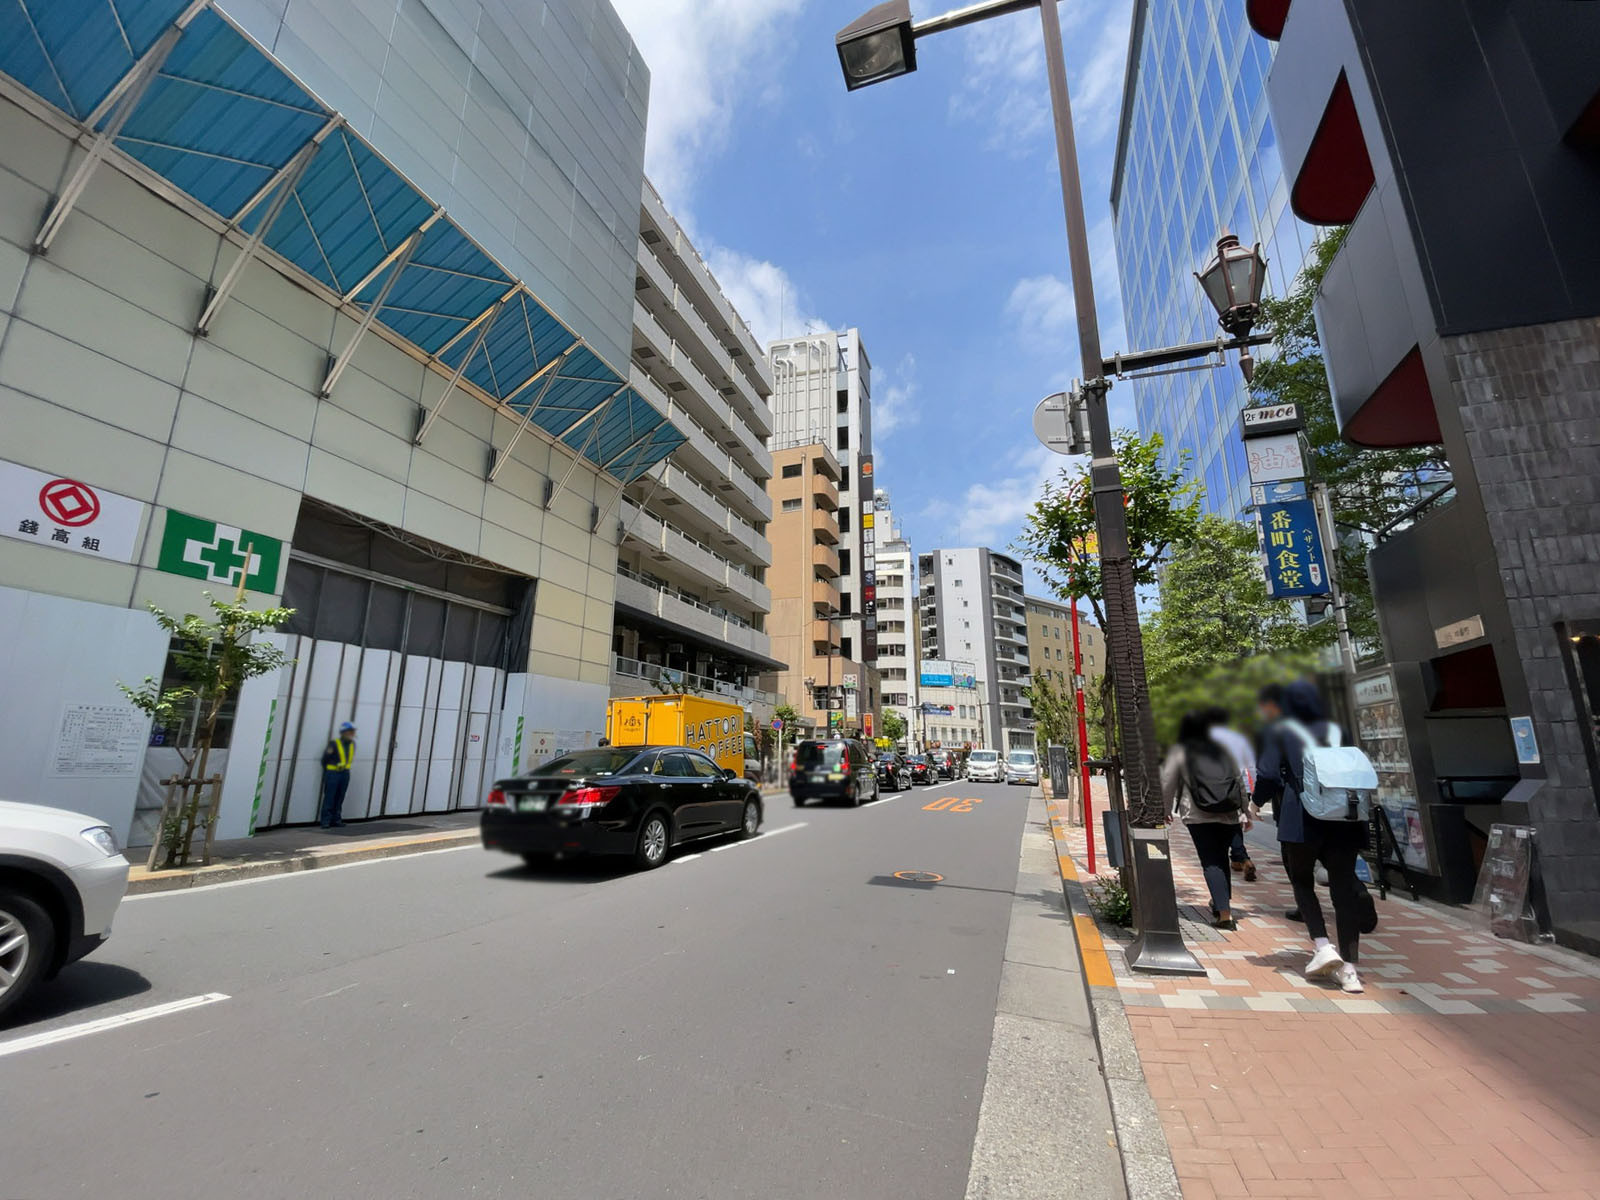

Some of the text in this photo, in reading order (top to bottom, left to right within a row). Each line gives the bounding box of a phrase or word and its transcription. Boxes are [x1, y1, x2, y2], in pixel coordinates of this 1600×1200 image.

[1245, 406, 1294, 422] 2F moe
[1269, 509, 1305, 590] 番町食堂
[685, 714, 741, 745] HATTORI
[921, 796, 984, 813] 30
